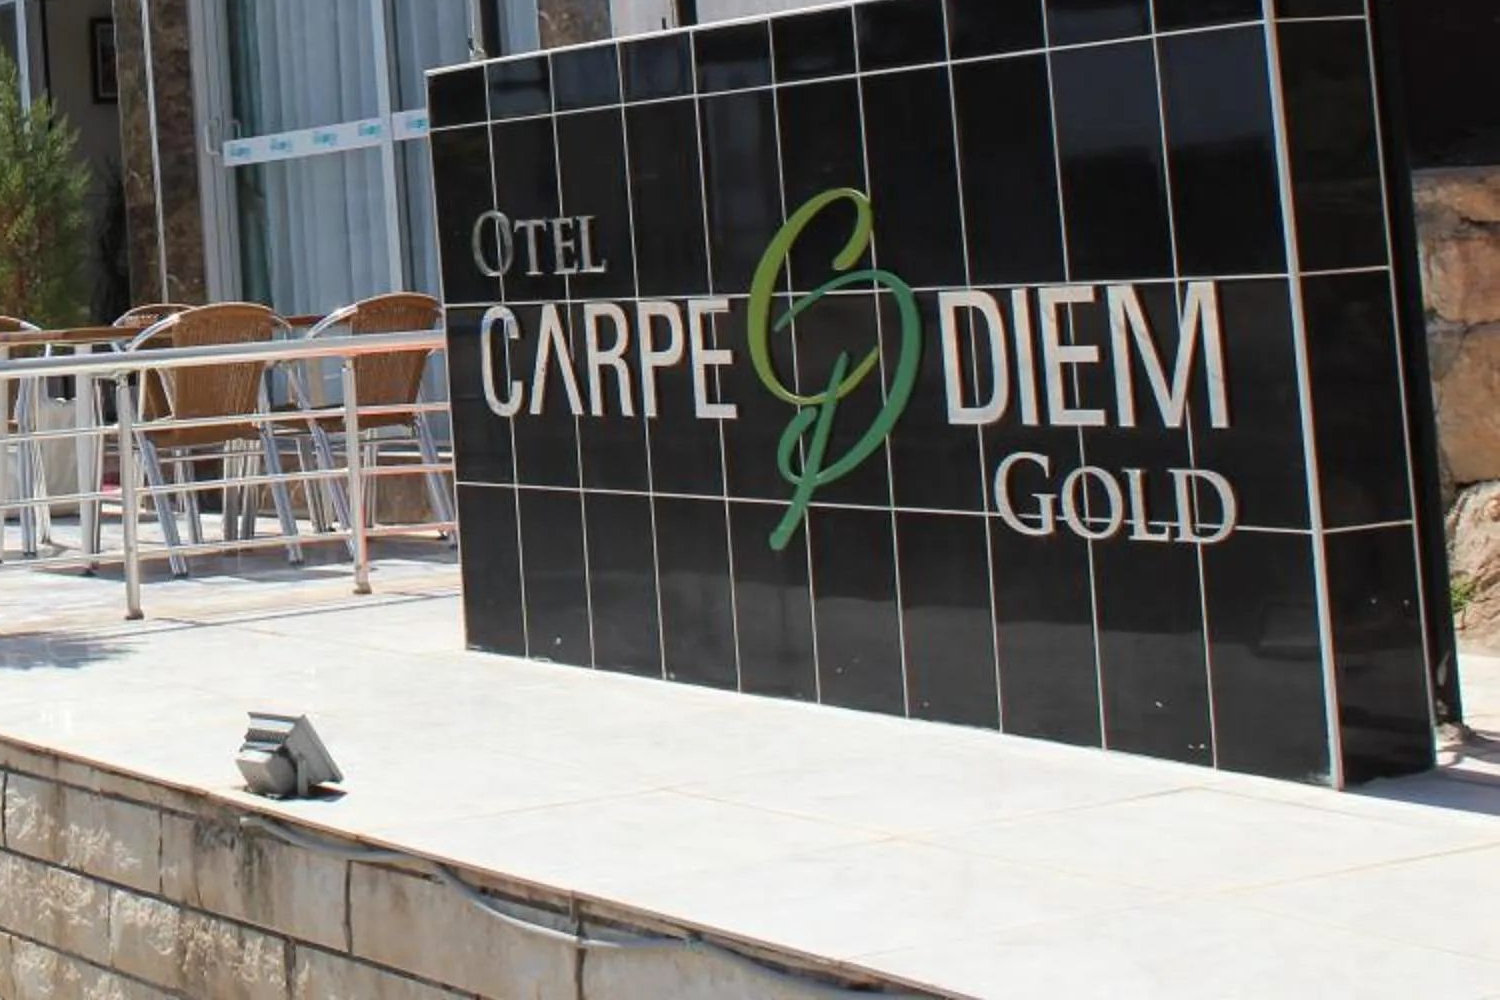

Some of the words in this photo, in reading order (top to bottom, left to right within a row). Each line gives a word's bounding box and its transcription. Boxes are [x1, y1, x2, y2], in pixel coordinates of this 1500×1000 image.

[472, 209, 607, 277] OTEL
[480, 296, 738, 420] CARPE
[937, 280, 1232, 430] DIEM
[992, 451, 1240, 544] GOLD
